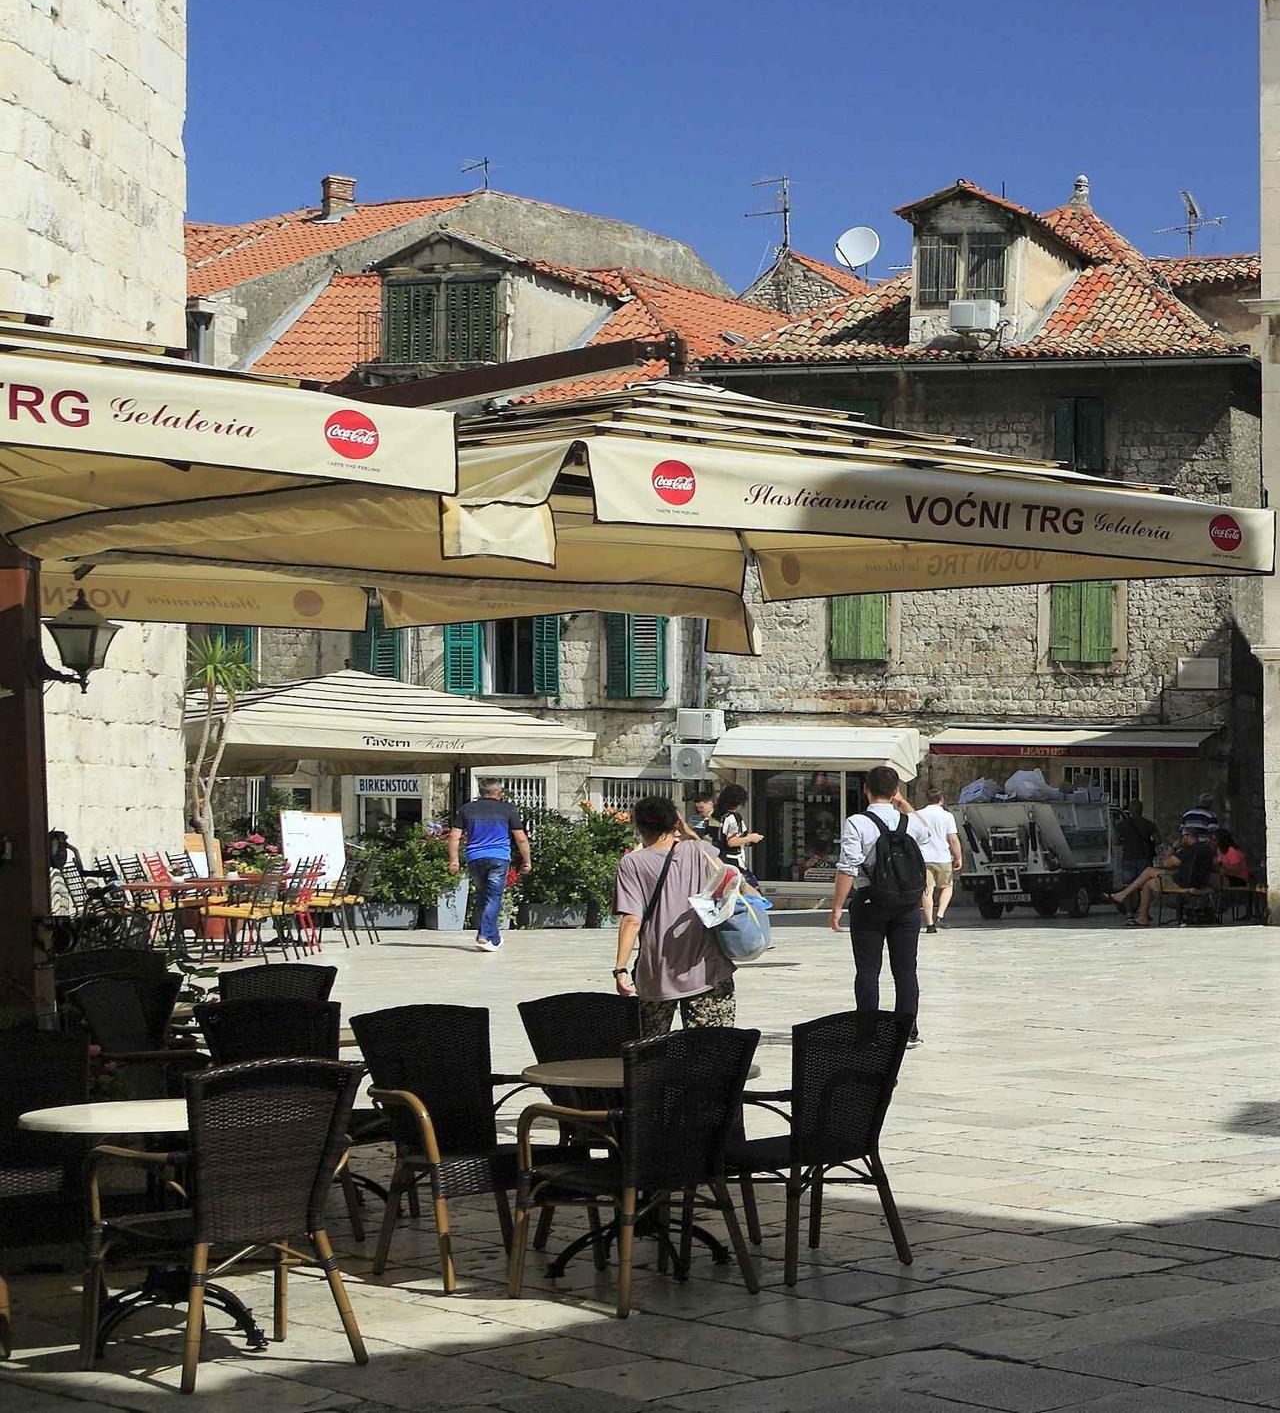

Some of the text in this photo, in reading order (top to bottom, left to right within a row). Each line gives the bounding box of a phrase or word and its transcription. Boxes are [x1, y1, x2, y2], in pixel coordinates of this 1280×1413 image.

[0, 382, 260, 439] RG Gelateria
[326, 424, 378, 445] Coca-Cola
[653, 475, 695, 491] Coca-Cola
[744, 483, 1175, 541] Slastičarnica VOĆNI TRG Gelateria
[362, 736, 410, 747] Tavern
[1020, 747, 1068, 756] LEATHER
[360, 778, 419, 792] BIRKENSTOCK
